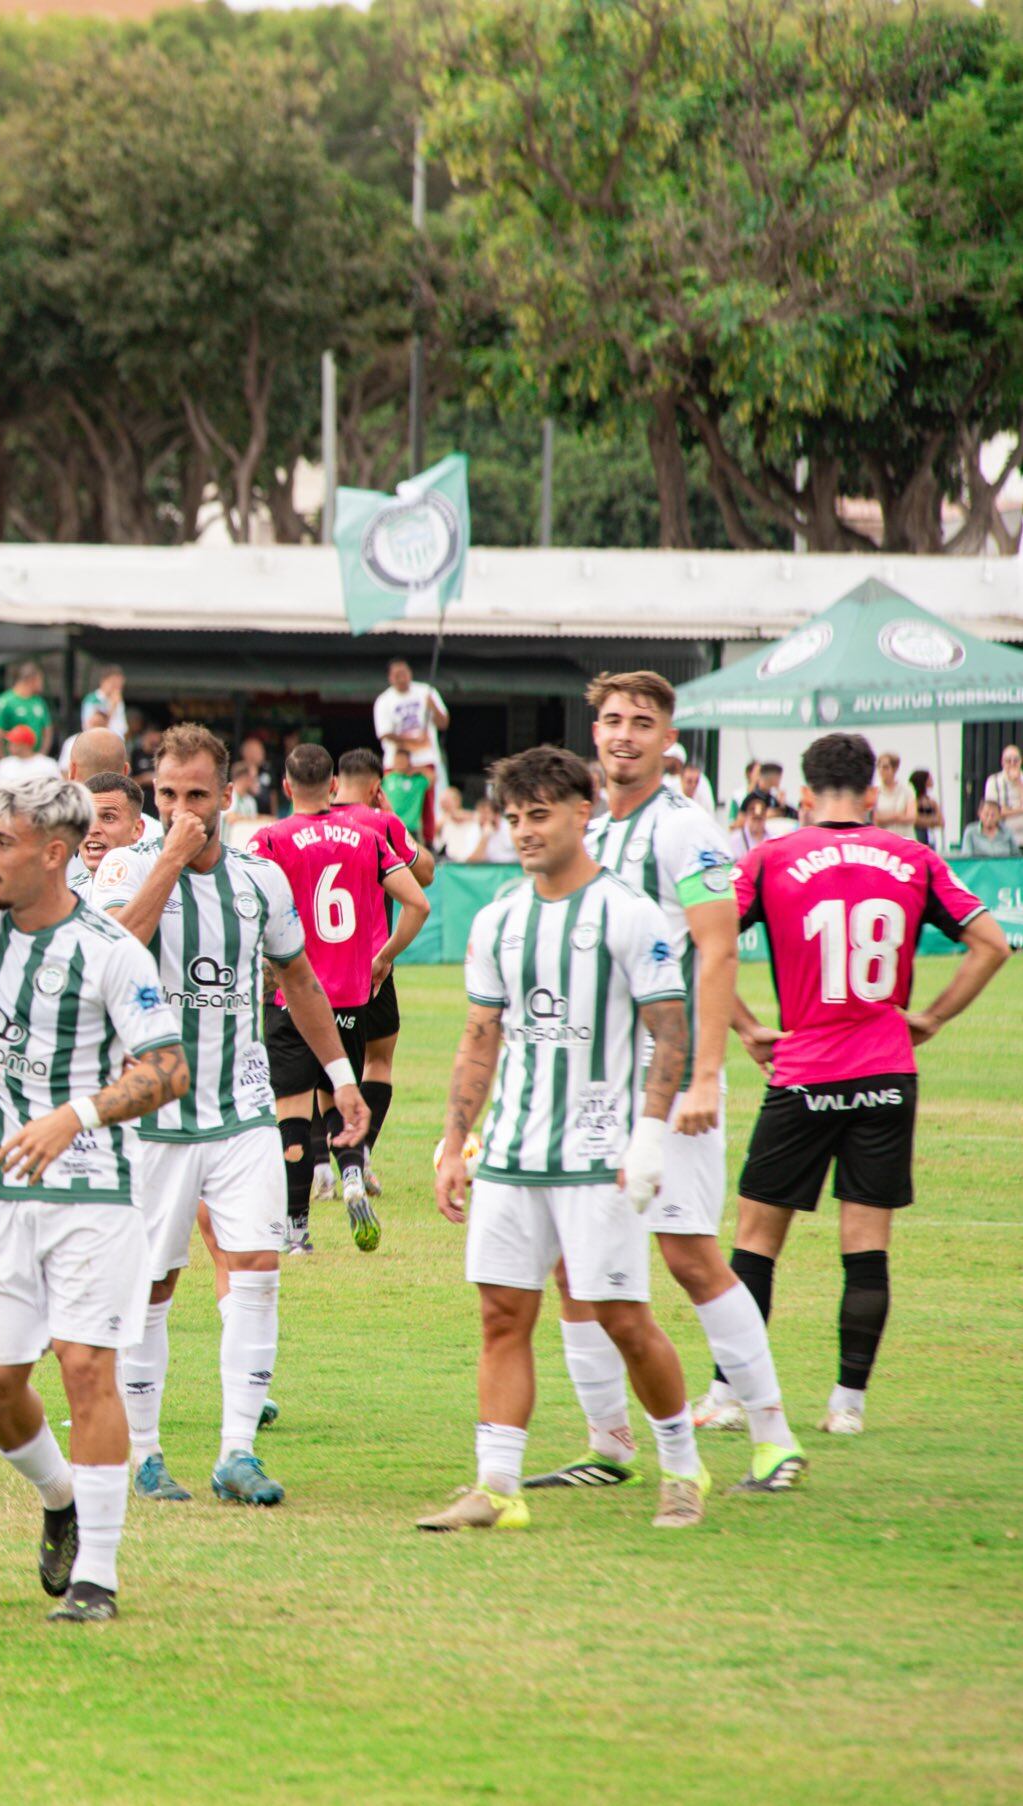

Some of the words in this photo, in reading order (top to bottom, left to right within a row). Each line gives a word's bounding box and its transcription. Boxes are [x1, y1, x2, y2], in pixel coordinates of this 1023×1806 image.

[853, 691, 933, 713] JUVENTUD
[292, 825, 322, 850] DEL
[323, 824, 361, 848] POZO
[787, 846, 842, 884] IAGO
[841, 843, 916, 883] INDIAS
[313, 862, 357, 944] 6
[803, 898, 906, 1003] 18
[804, 1088, 903, 1111] VALANS
